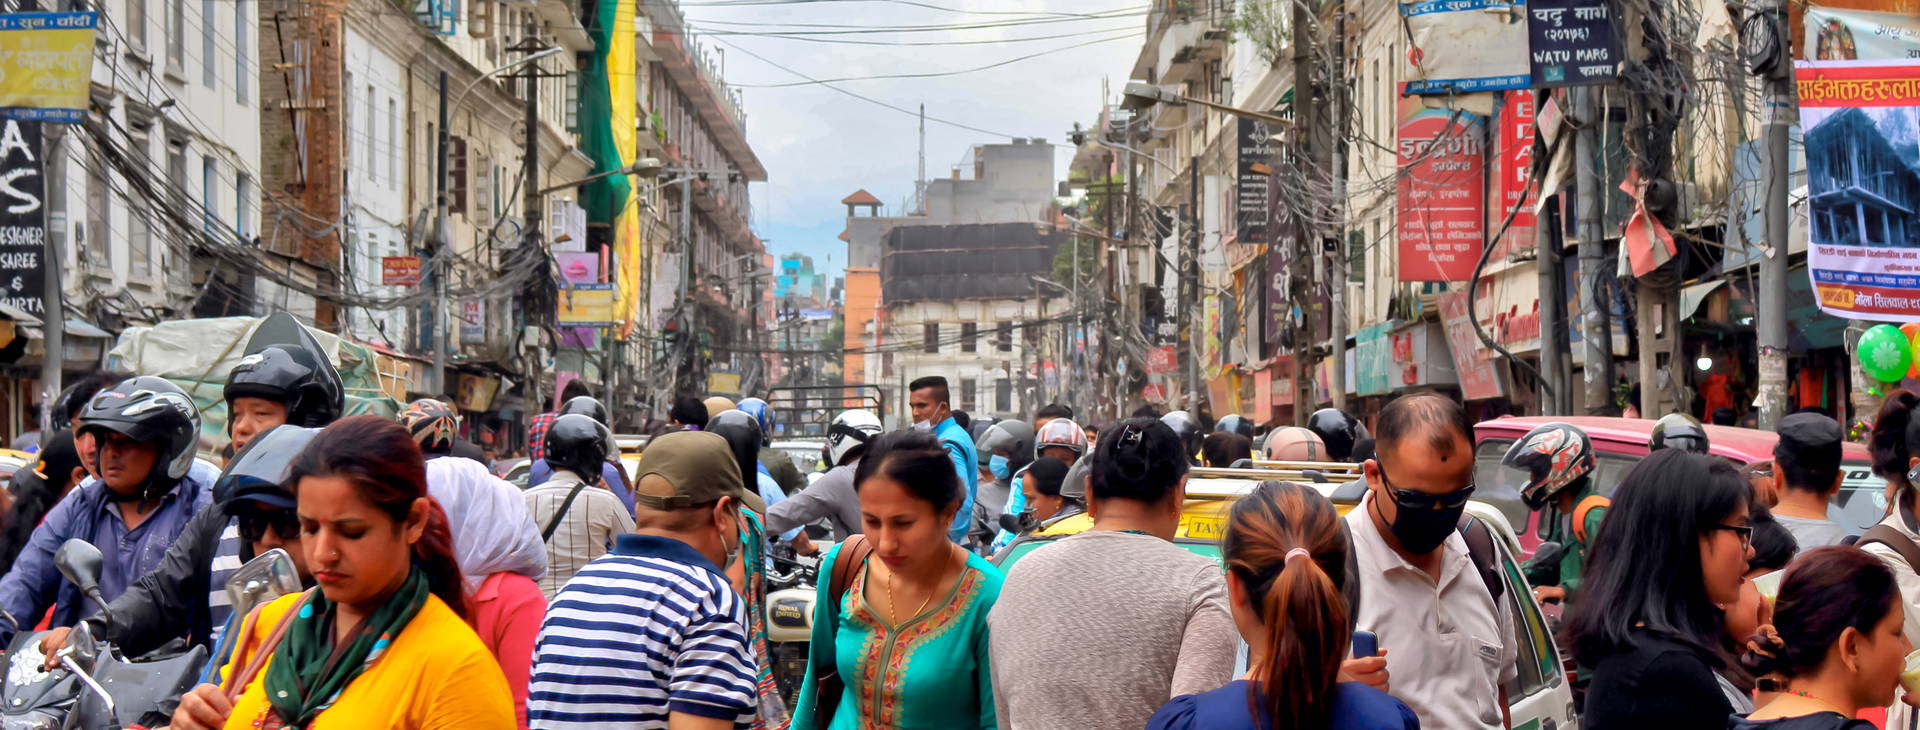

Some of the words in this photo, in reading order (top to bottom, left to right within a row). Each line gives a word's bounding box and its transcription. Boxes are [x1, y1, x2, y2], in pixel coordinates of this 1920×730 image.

[1534, 50, 1570, 65] WATU
[1576, 48, 1609, 61] MARG
[0, 252, 38, 269] SAREE
